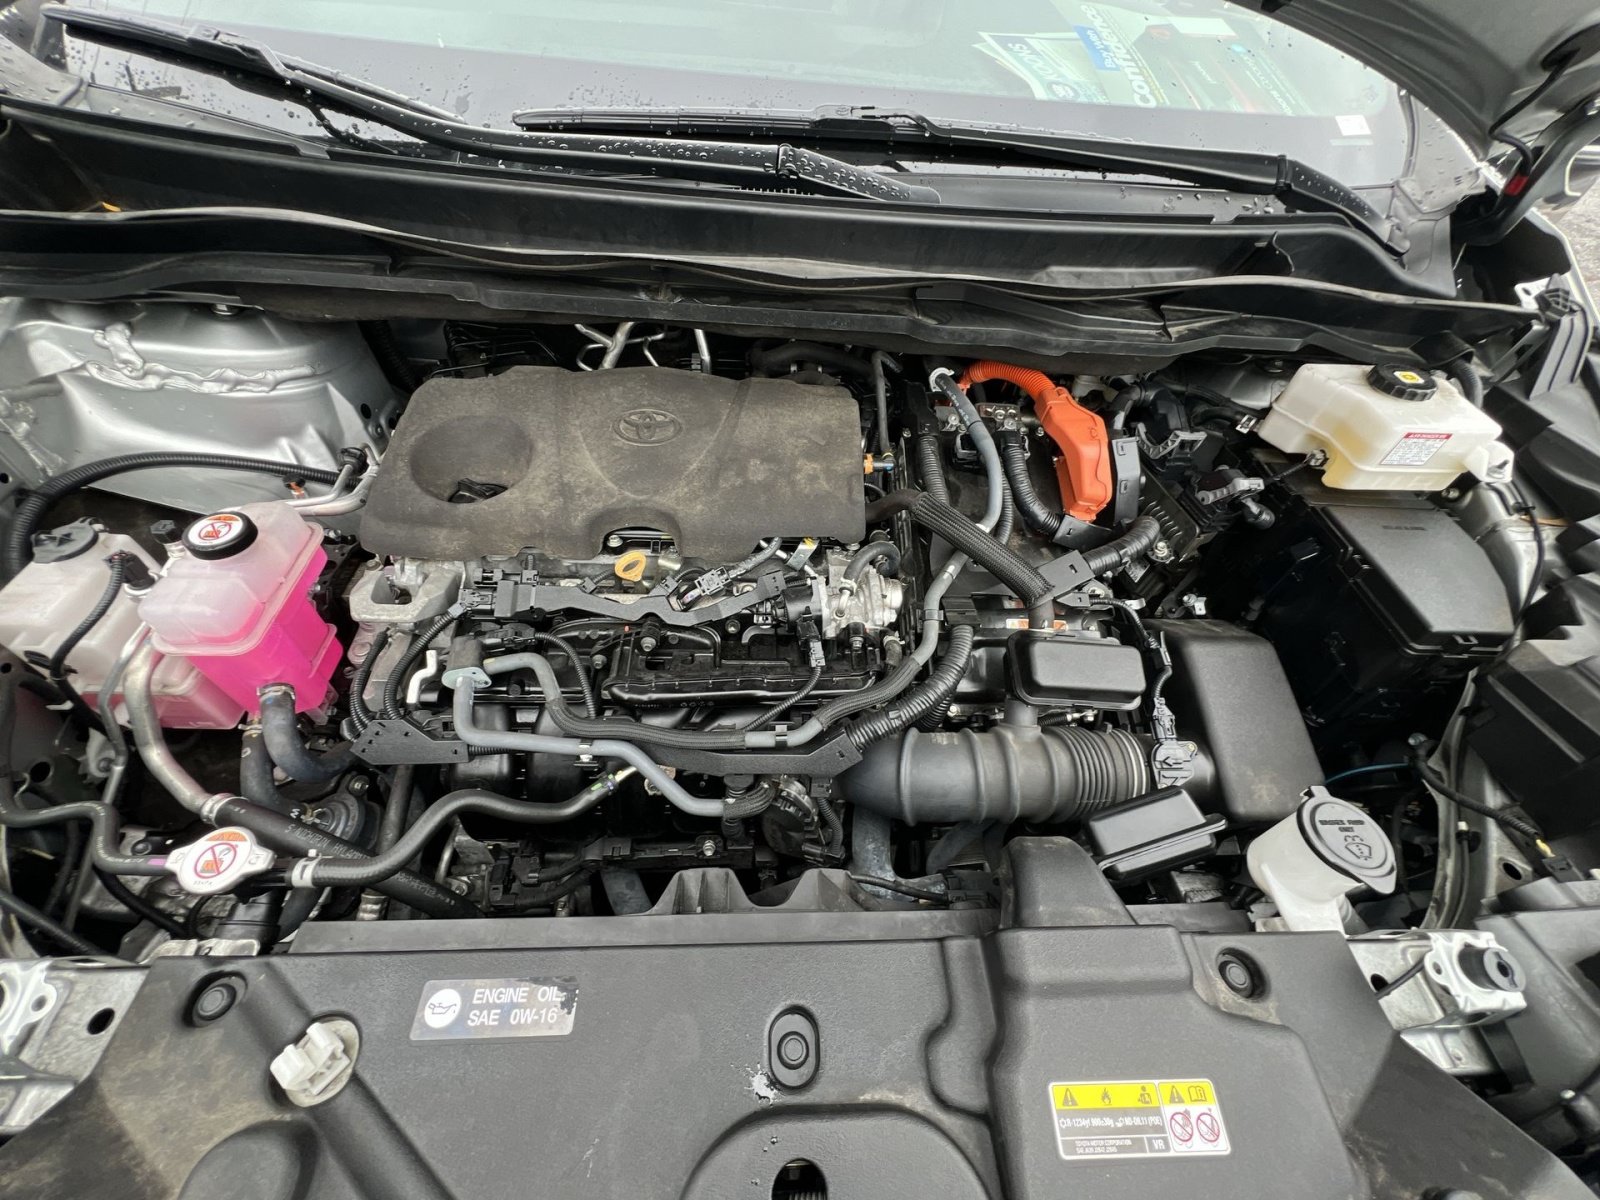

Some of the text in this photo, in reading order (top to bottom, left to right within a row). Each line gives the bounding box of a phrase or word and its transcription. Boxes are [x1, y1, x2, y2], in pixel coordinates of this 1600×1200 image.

[1008, 42, 1063, 82] KOONS
[472, 986, 563, 1004] ENGINE OIL
[467, 1008, 558, 1026] SAE 0W-16
[1152, 1139, 1165, 1150] VR
